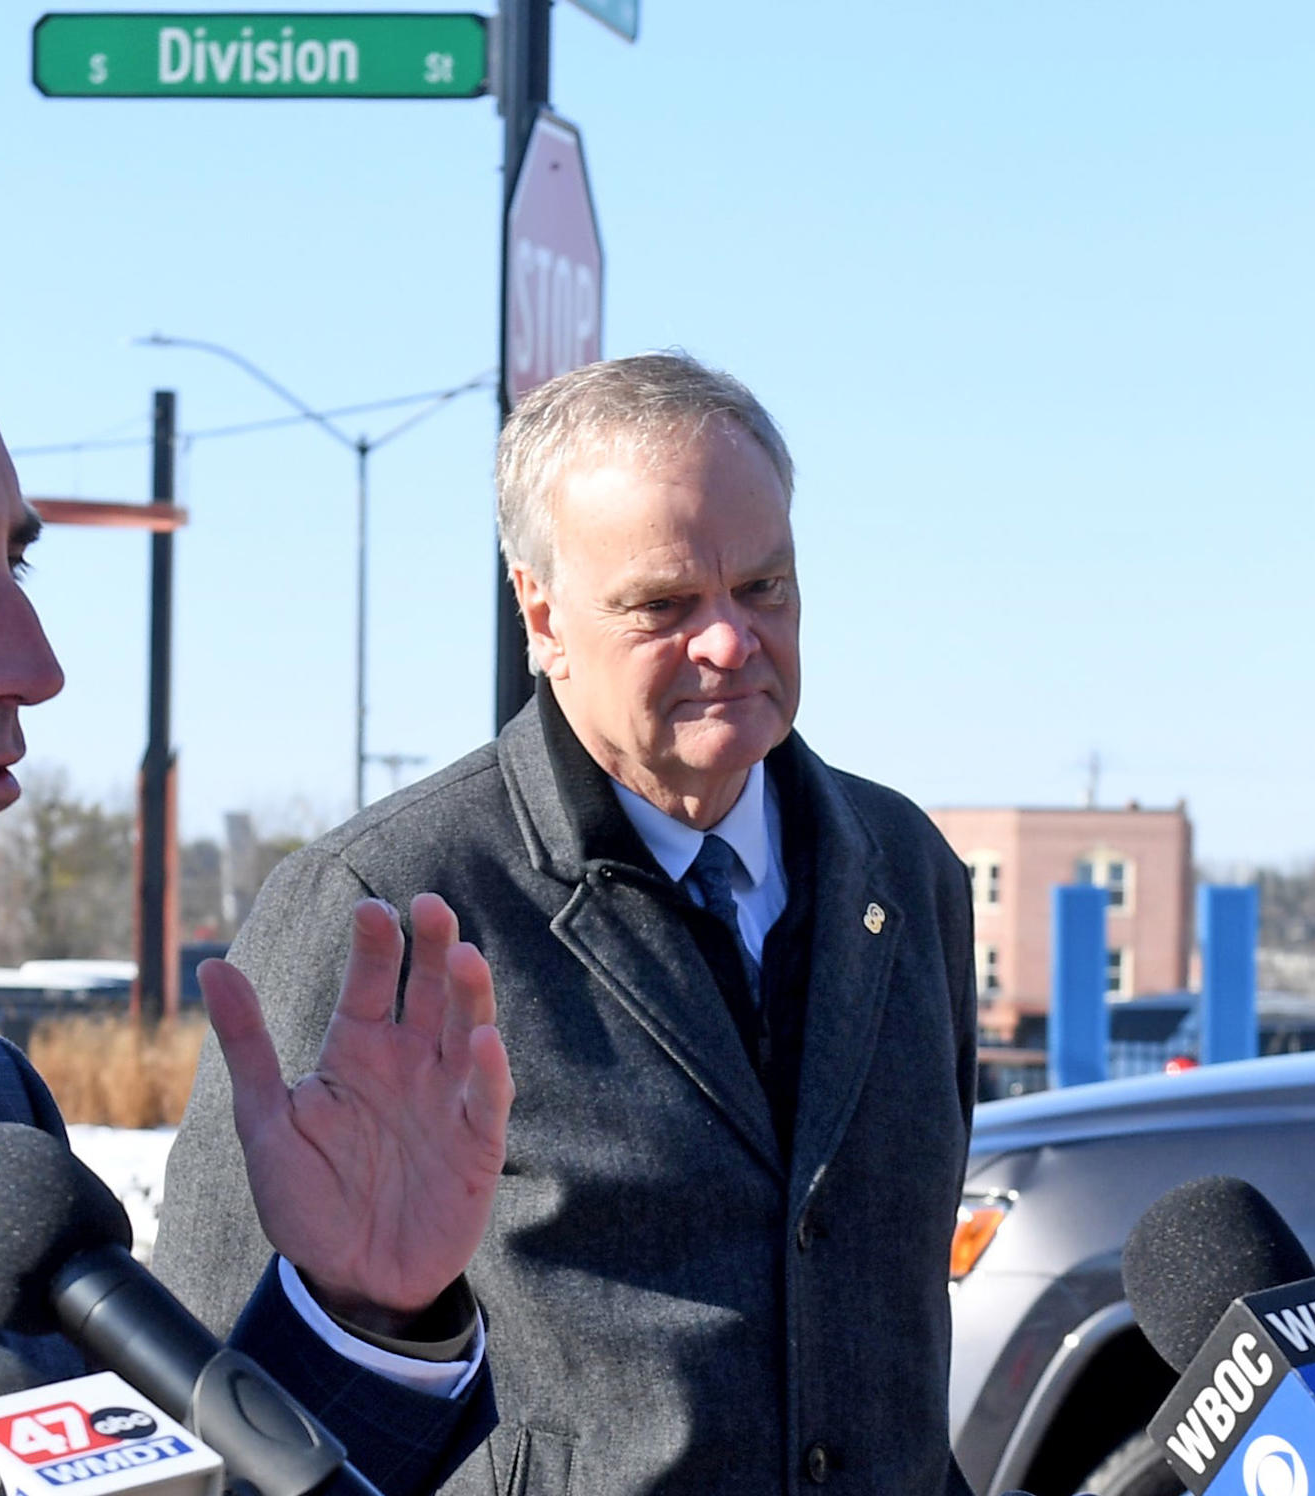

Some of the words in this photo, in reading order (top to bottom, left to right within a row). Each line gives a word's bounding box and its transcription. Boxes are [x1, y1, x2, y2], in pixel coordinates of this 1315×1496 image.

[89, 54, 108, 84] S
[159, 28, 359, 84] Division
[424, 53, 454, 84] St
[513, 237, 598, 379] STOP
[9, 1406, 91, 1455] 47
[93, 1412, 152, 1436] abc
[1166, 1332, 1273, 1476] WBOC
[42, 1437, 186, 1484] WMDT
